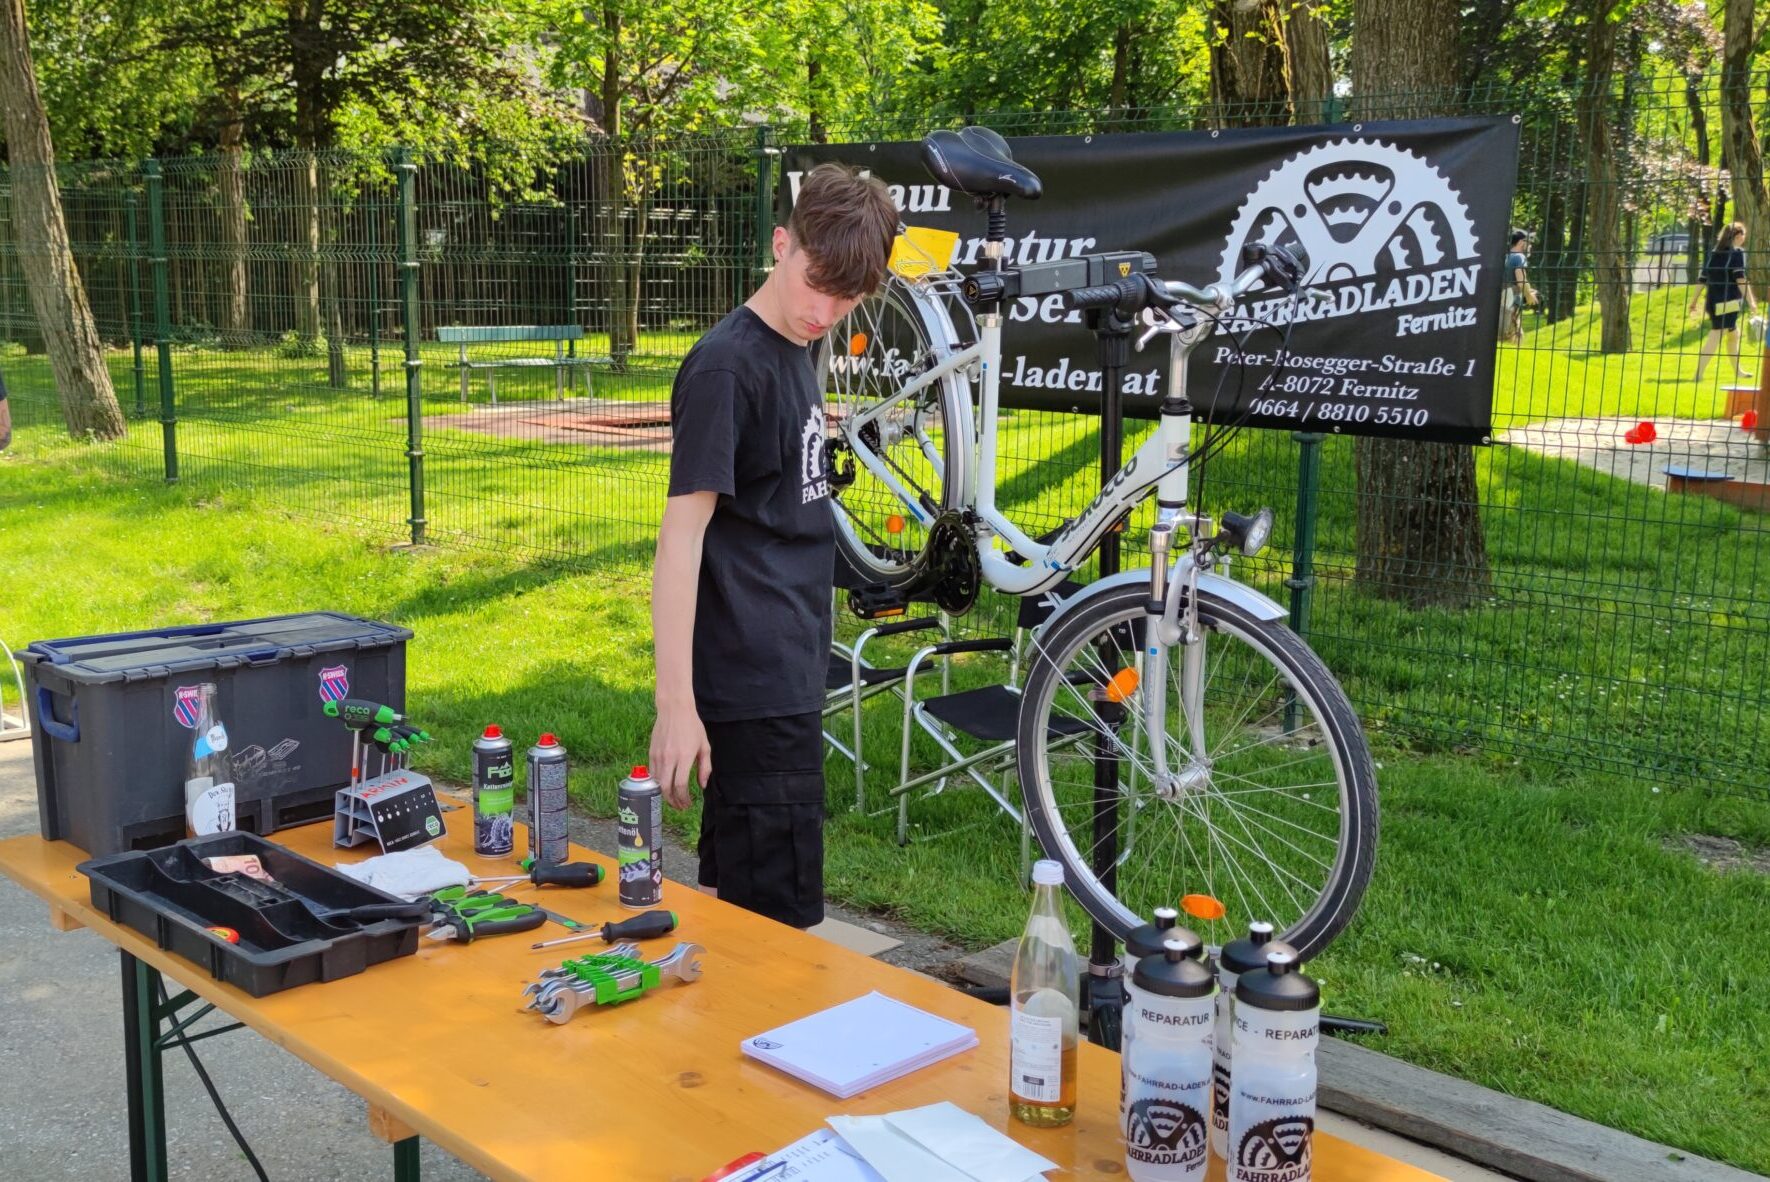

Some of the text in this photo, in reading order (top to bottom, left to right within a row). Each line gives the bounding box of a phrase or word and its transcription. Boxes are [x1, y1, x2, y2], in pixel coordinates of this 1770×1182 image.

[1215, 264, 1482, 336] FAHRRADLADEN
[1395, 307, 1477, 337] Fernitz
[1213, 346, 1476, 377] Peter-Rosegger-Straße 1
[1257, 374, 1420, 400] A-8072 Fernitz
[1317, 403, 1369, 423] 8810
[1374, 406, 1429, 427] 5510
[1141, 1008, 1210, 1026] REPARATUR
